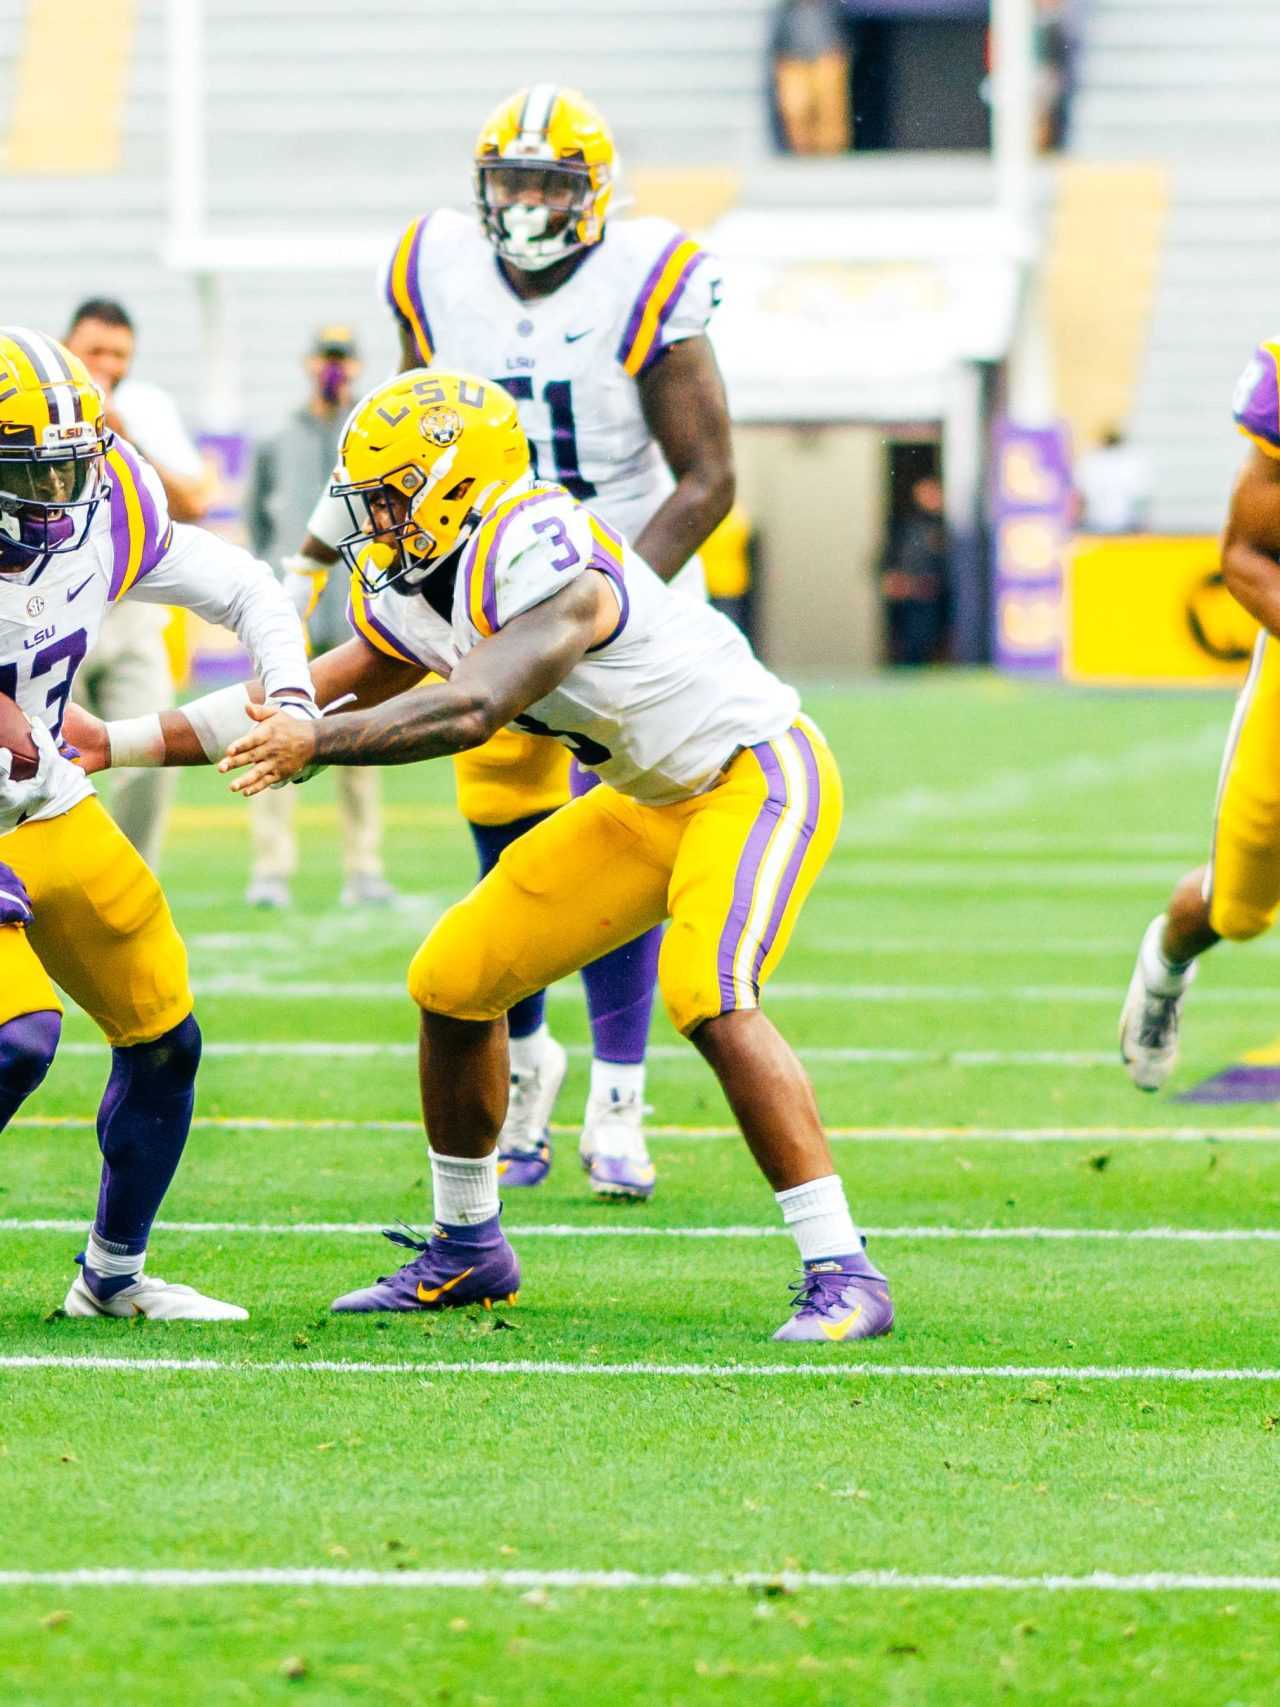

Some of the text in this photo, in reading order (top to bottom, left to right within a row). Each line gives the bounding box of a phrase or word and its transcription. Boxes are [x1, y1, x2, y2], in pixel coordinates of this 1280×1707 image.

[375, 379, 485, 428] LSU
[57, 426, 83, 440] LSU
[532, 516, 581, 573] 3
[23, 624, 56, 650] LSU
